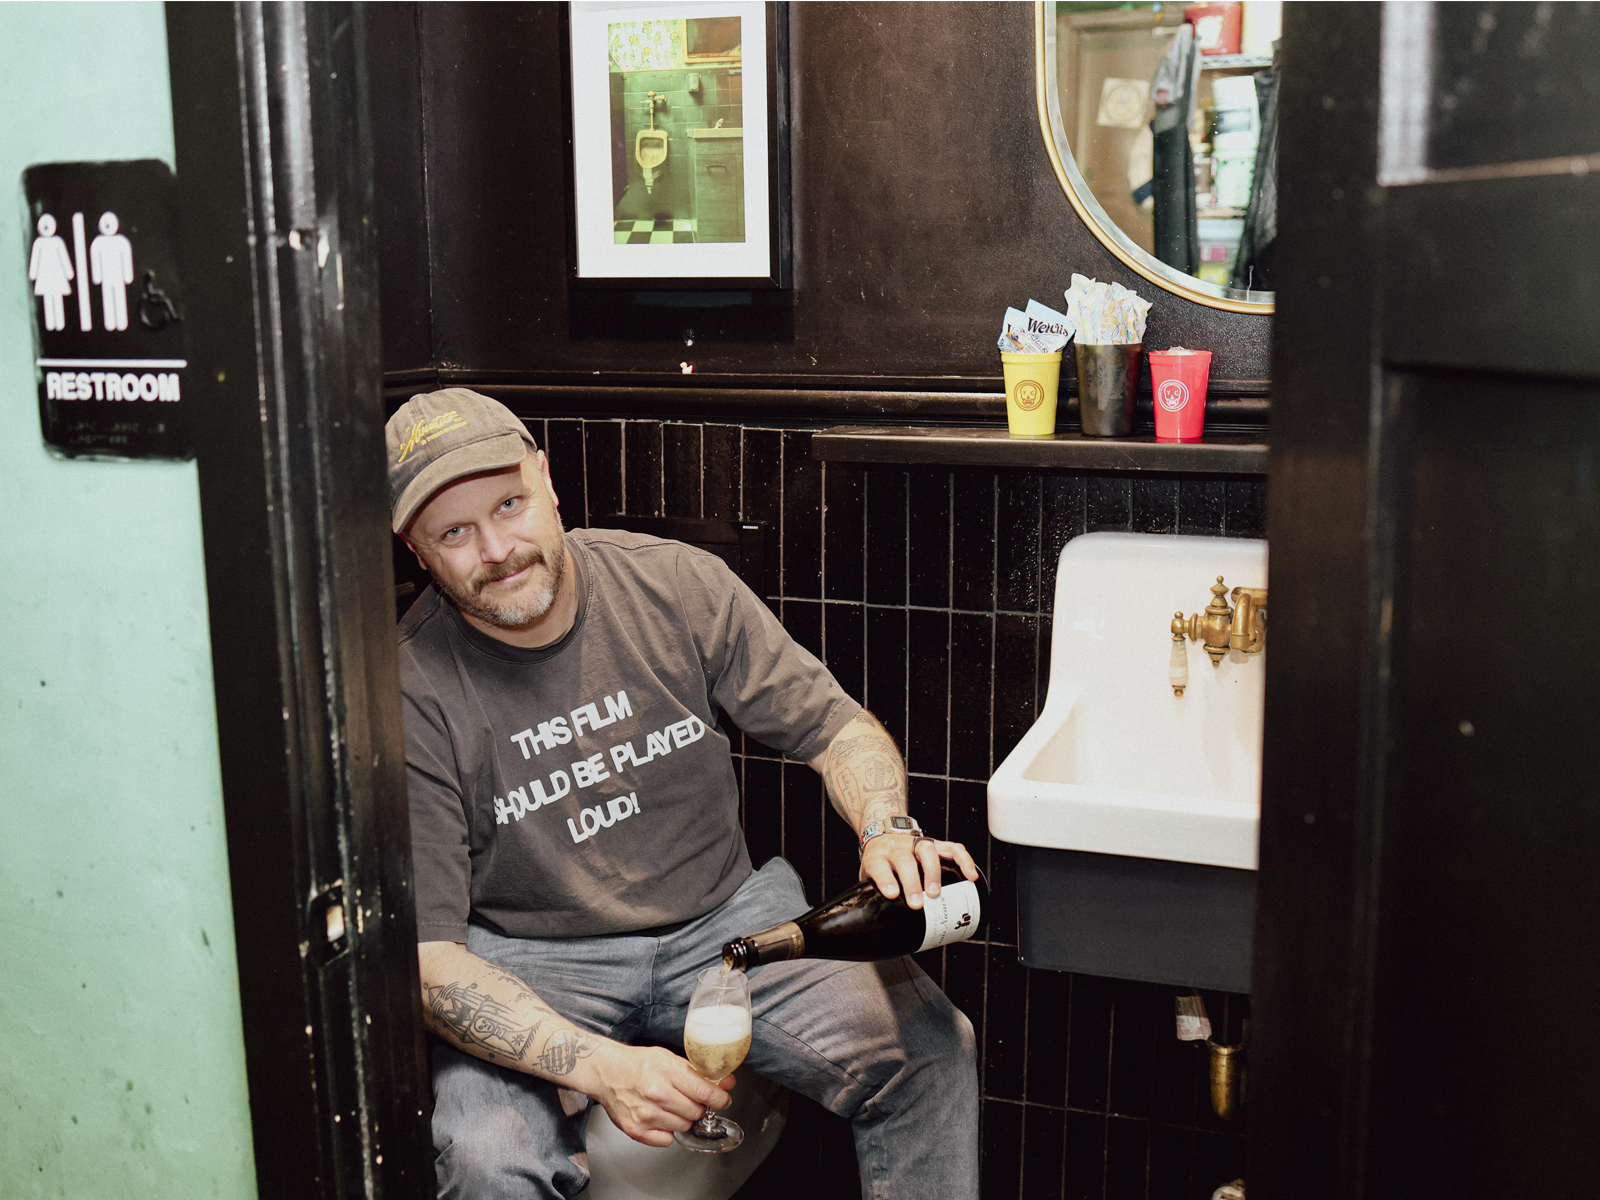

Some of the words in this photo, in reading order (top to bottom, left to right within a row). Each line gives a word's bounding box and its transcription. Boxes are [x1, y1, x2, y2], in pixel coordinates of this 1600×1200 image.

[46, 372, 181, 402] RESTROOM
[510, 716, 573, 760] THIS
[570, 690, 633, 737] FILM
[493, 769, 571, 825] SHOULD
[571, 752, 611, 789] BE
[610, 715, 706, 773] PLAYED
[567, 792, 641, 844] LOUD!
